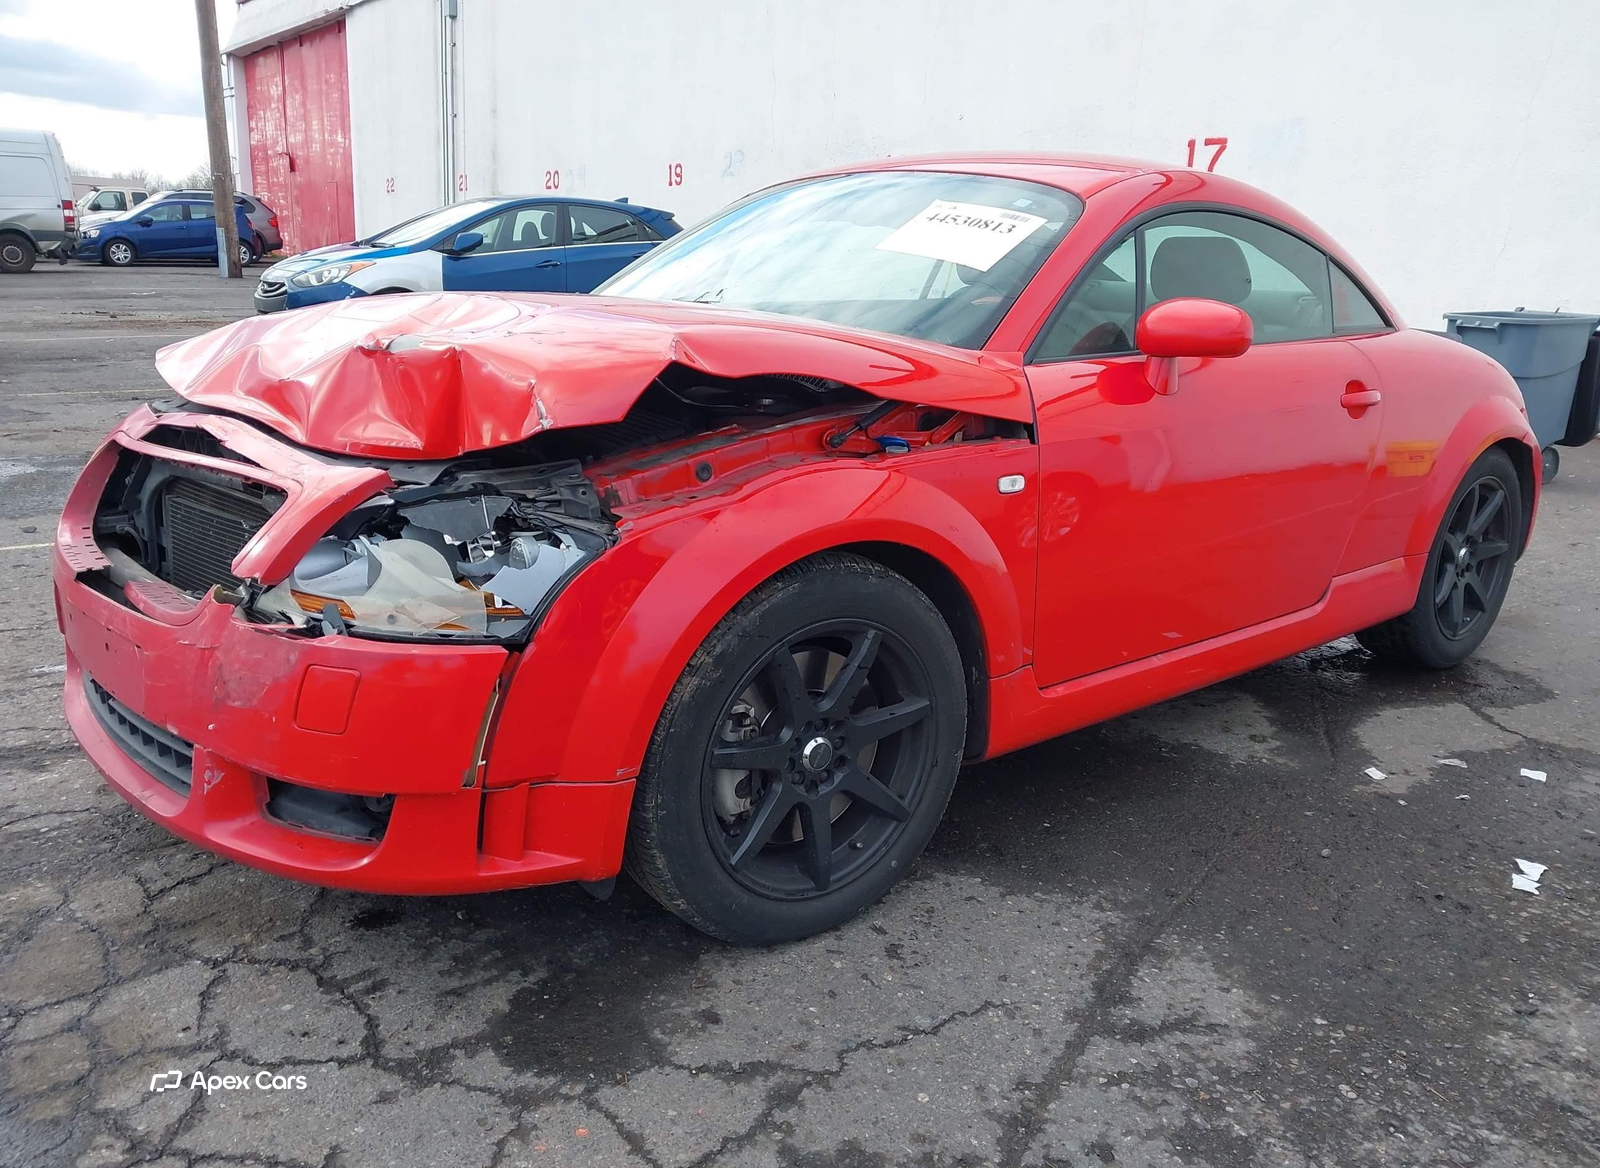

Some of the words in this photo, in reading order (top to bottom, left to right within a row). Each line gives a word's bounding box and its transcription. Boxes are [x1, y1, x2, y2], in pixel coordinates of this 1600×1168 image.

[1187, 137, 1228, 172] 17
[385, 177, 395, 193] 22
[458, 174, 468, 191] 21
[545, 170, 560, 190] 20
[667, 163, 683, 187] 19
[926, 212, 1017, 235] 44530813
